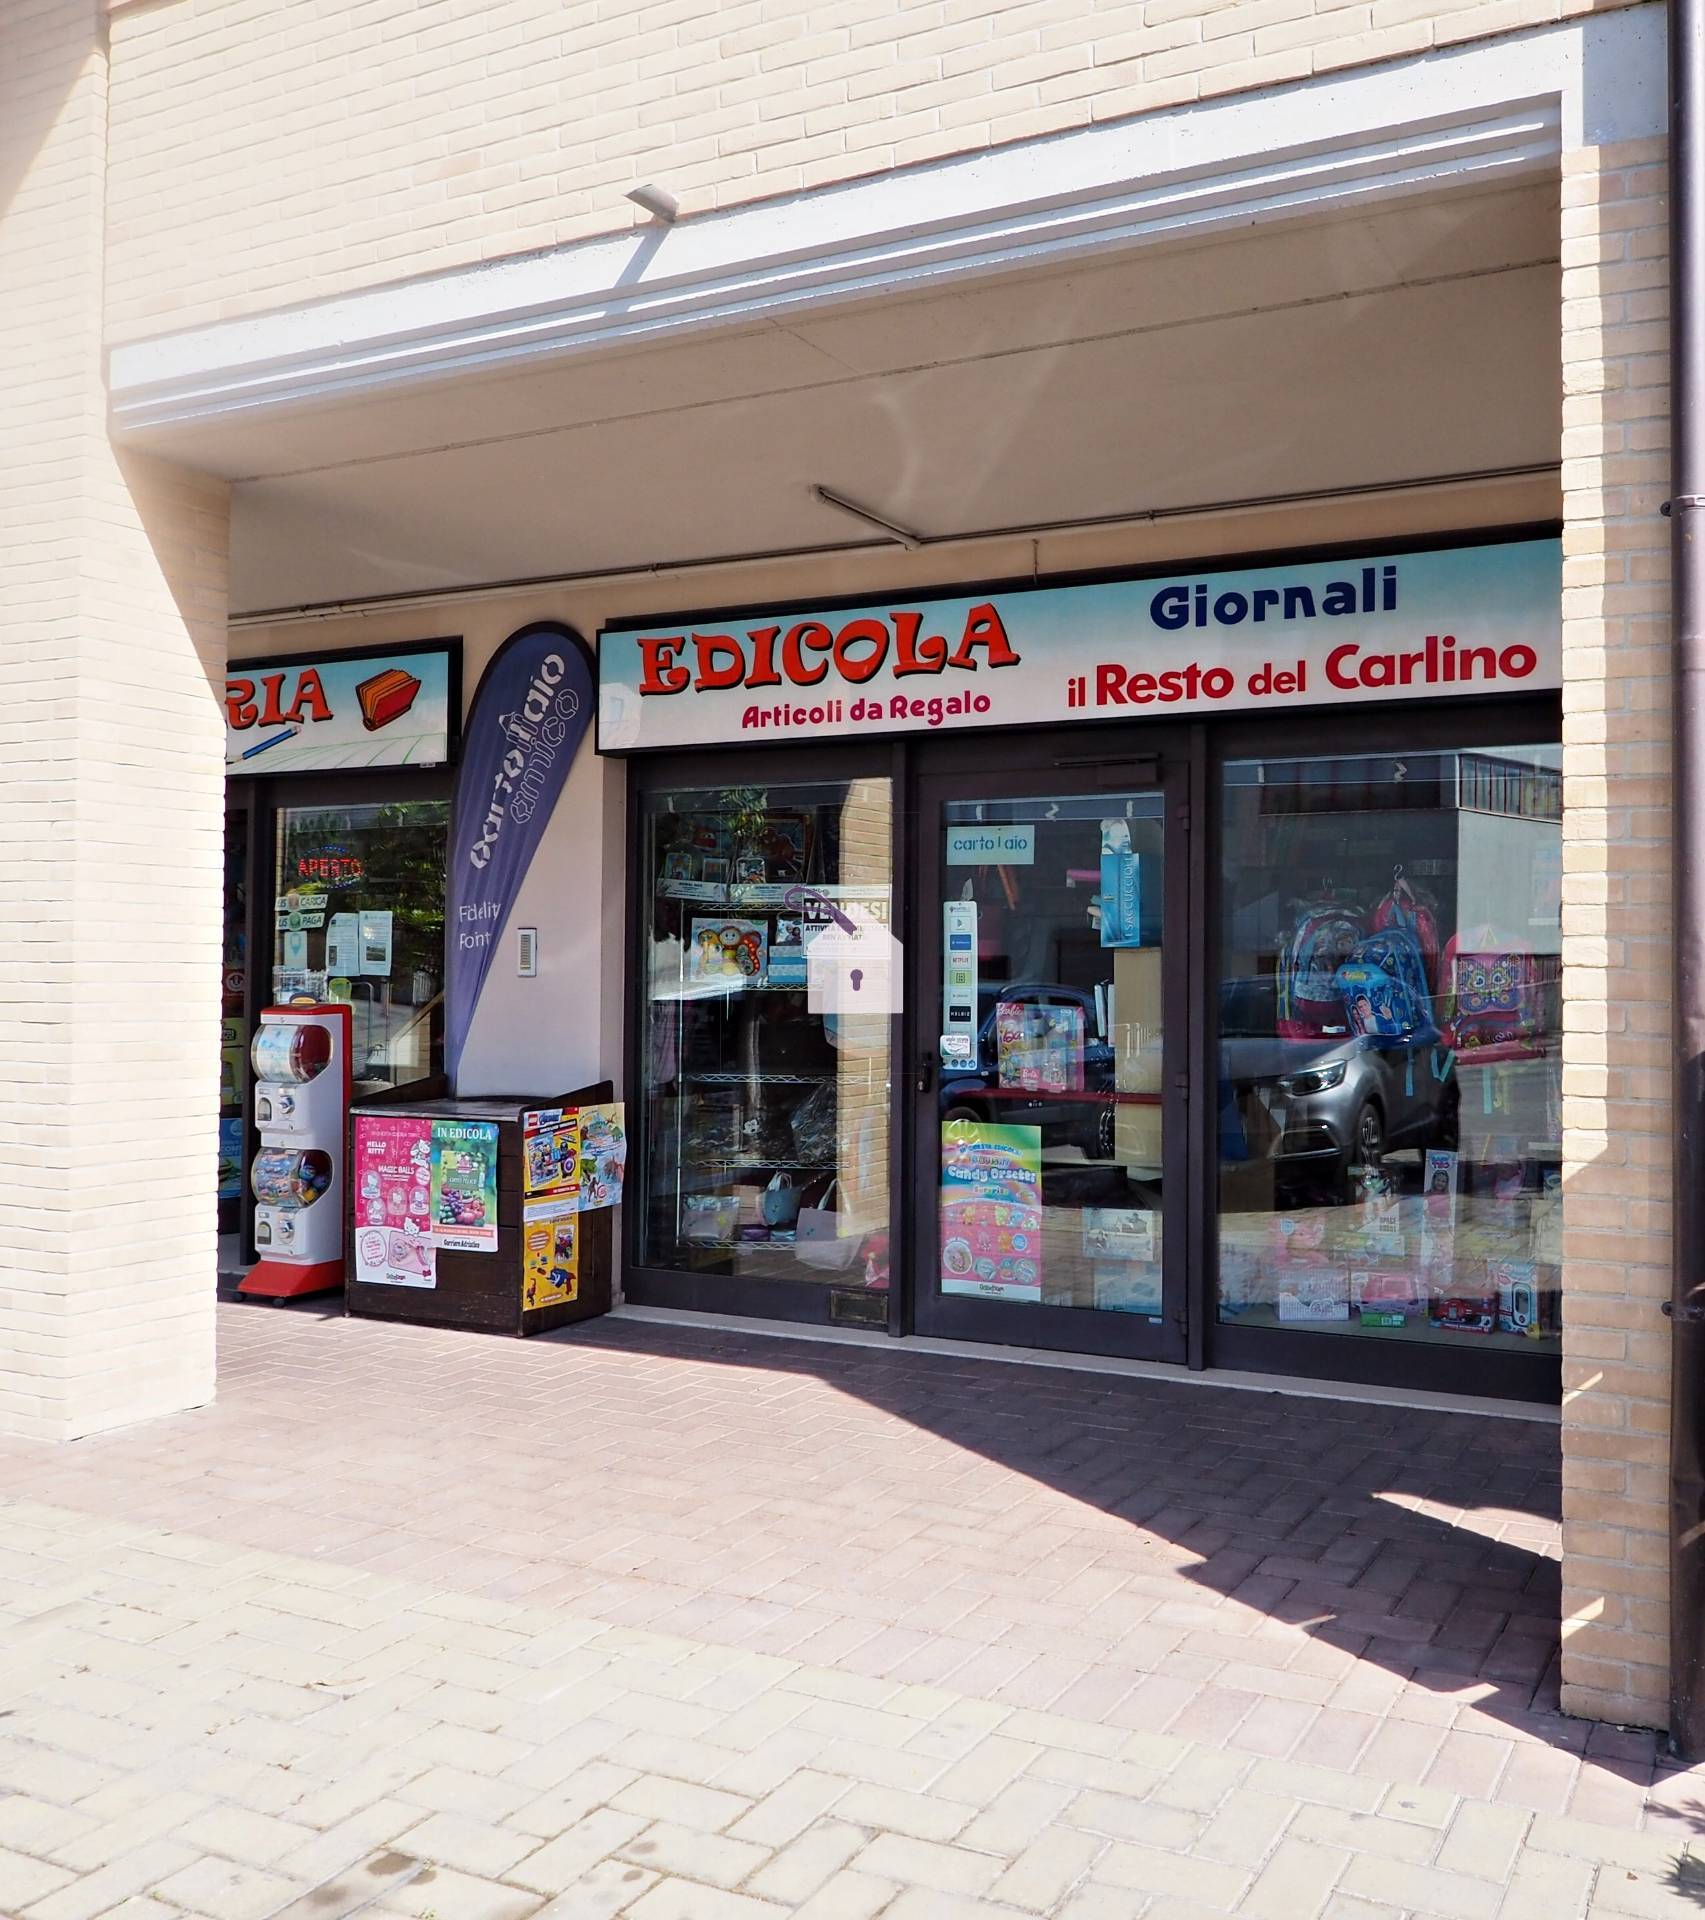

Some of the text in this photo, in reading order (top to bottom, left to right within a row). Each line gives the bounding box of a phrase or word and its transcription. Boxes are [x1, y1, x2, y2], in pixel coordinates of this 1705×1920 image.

[1150, 565, 1397, 631] Giornali
[637, 602, 1022, 697] EDICOLA
[1067, 635, 1537, 708] il Resto del Carlino
[742, 690, 991, 729] Articoli da Regalo
[298, 858, 364, 879] APERTO
[437, 1127, 492, 1141] IN EDICOLA
[367, 1147, 385, 1155] KITTY
[378, 1165, 415, 1175] MAGIC BALLS
[947, 1164, 988, 1183] Candy
